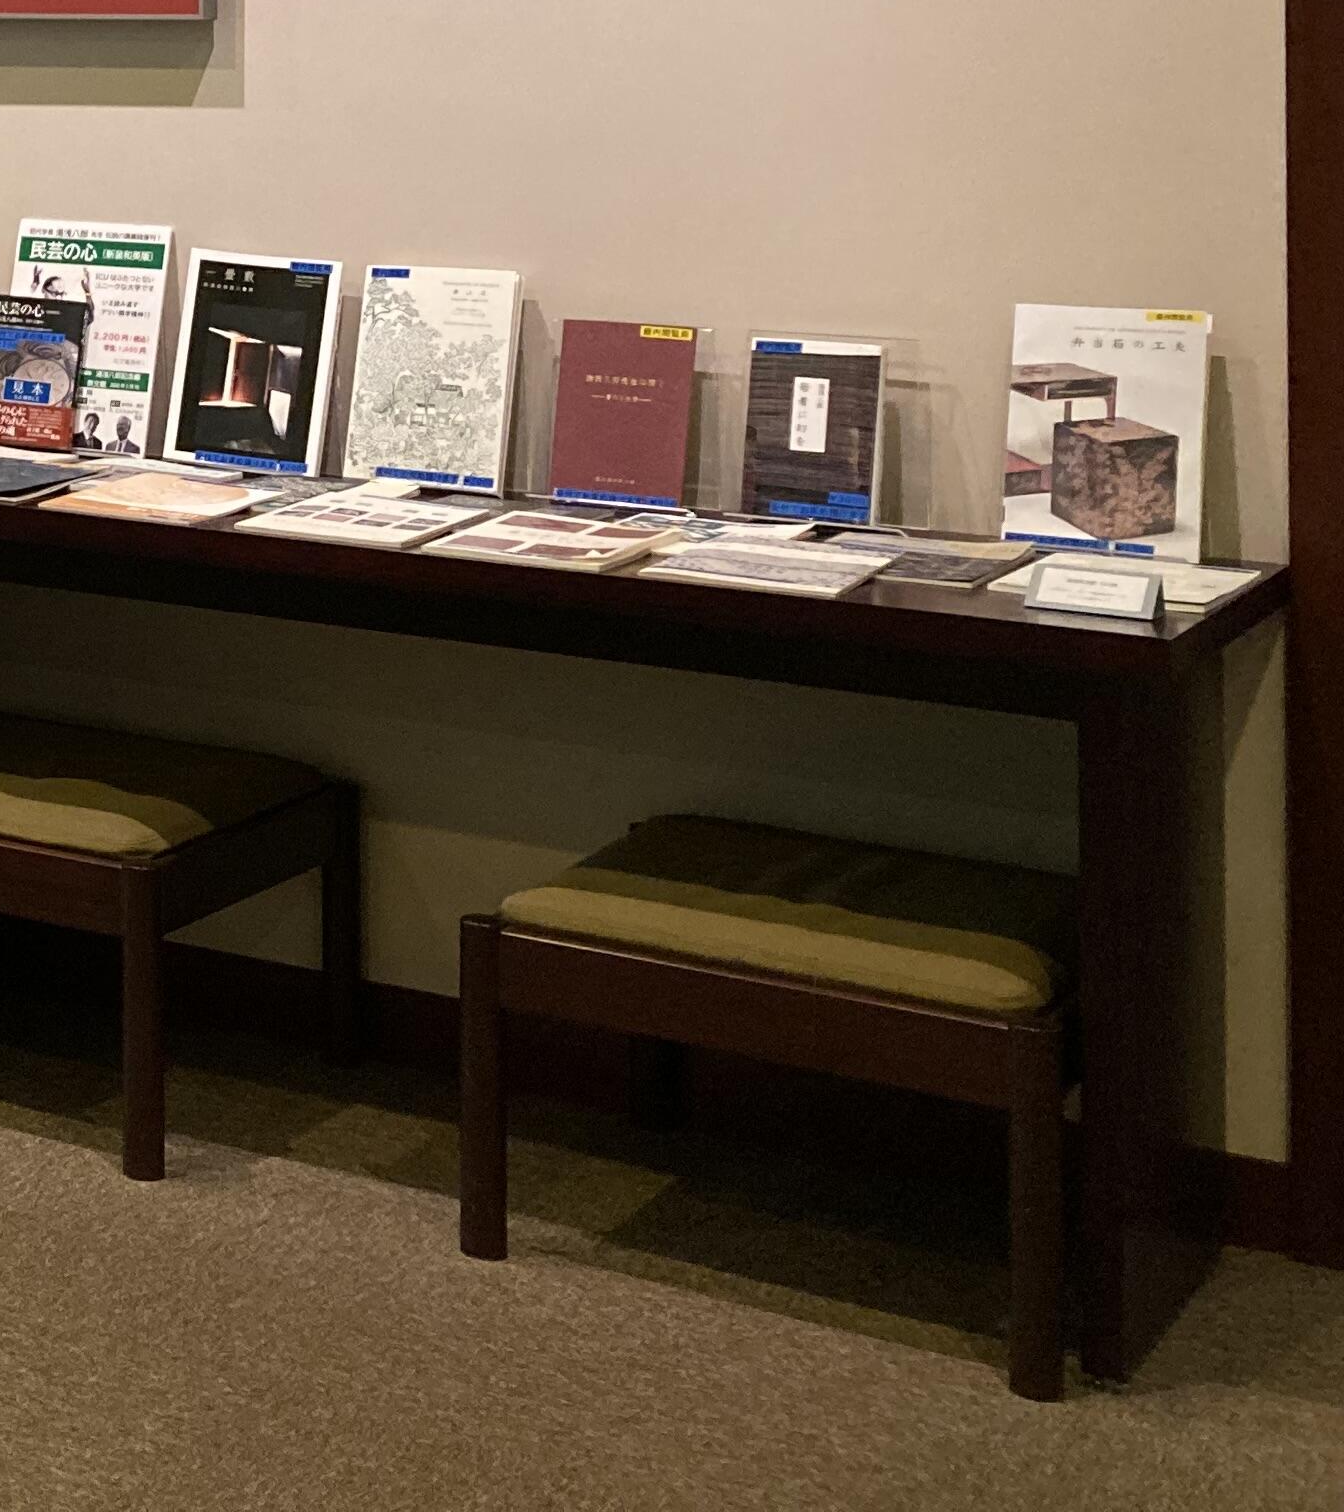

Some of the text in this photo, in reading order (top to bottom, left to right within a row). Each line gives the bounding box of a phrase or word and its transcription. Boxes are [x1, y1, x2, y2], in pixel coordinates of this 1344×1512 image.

[29, 240, 97, 262] 民芸の心
[12, 381, 44, 395] 見本
